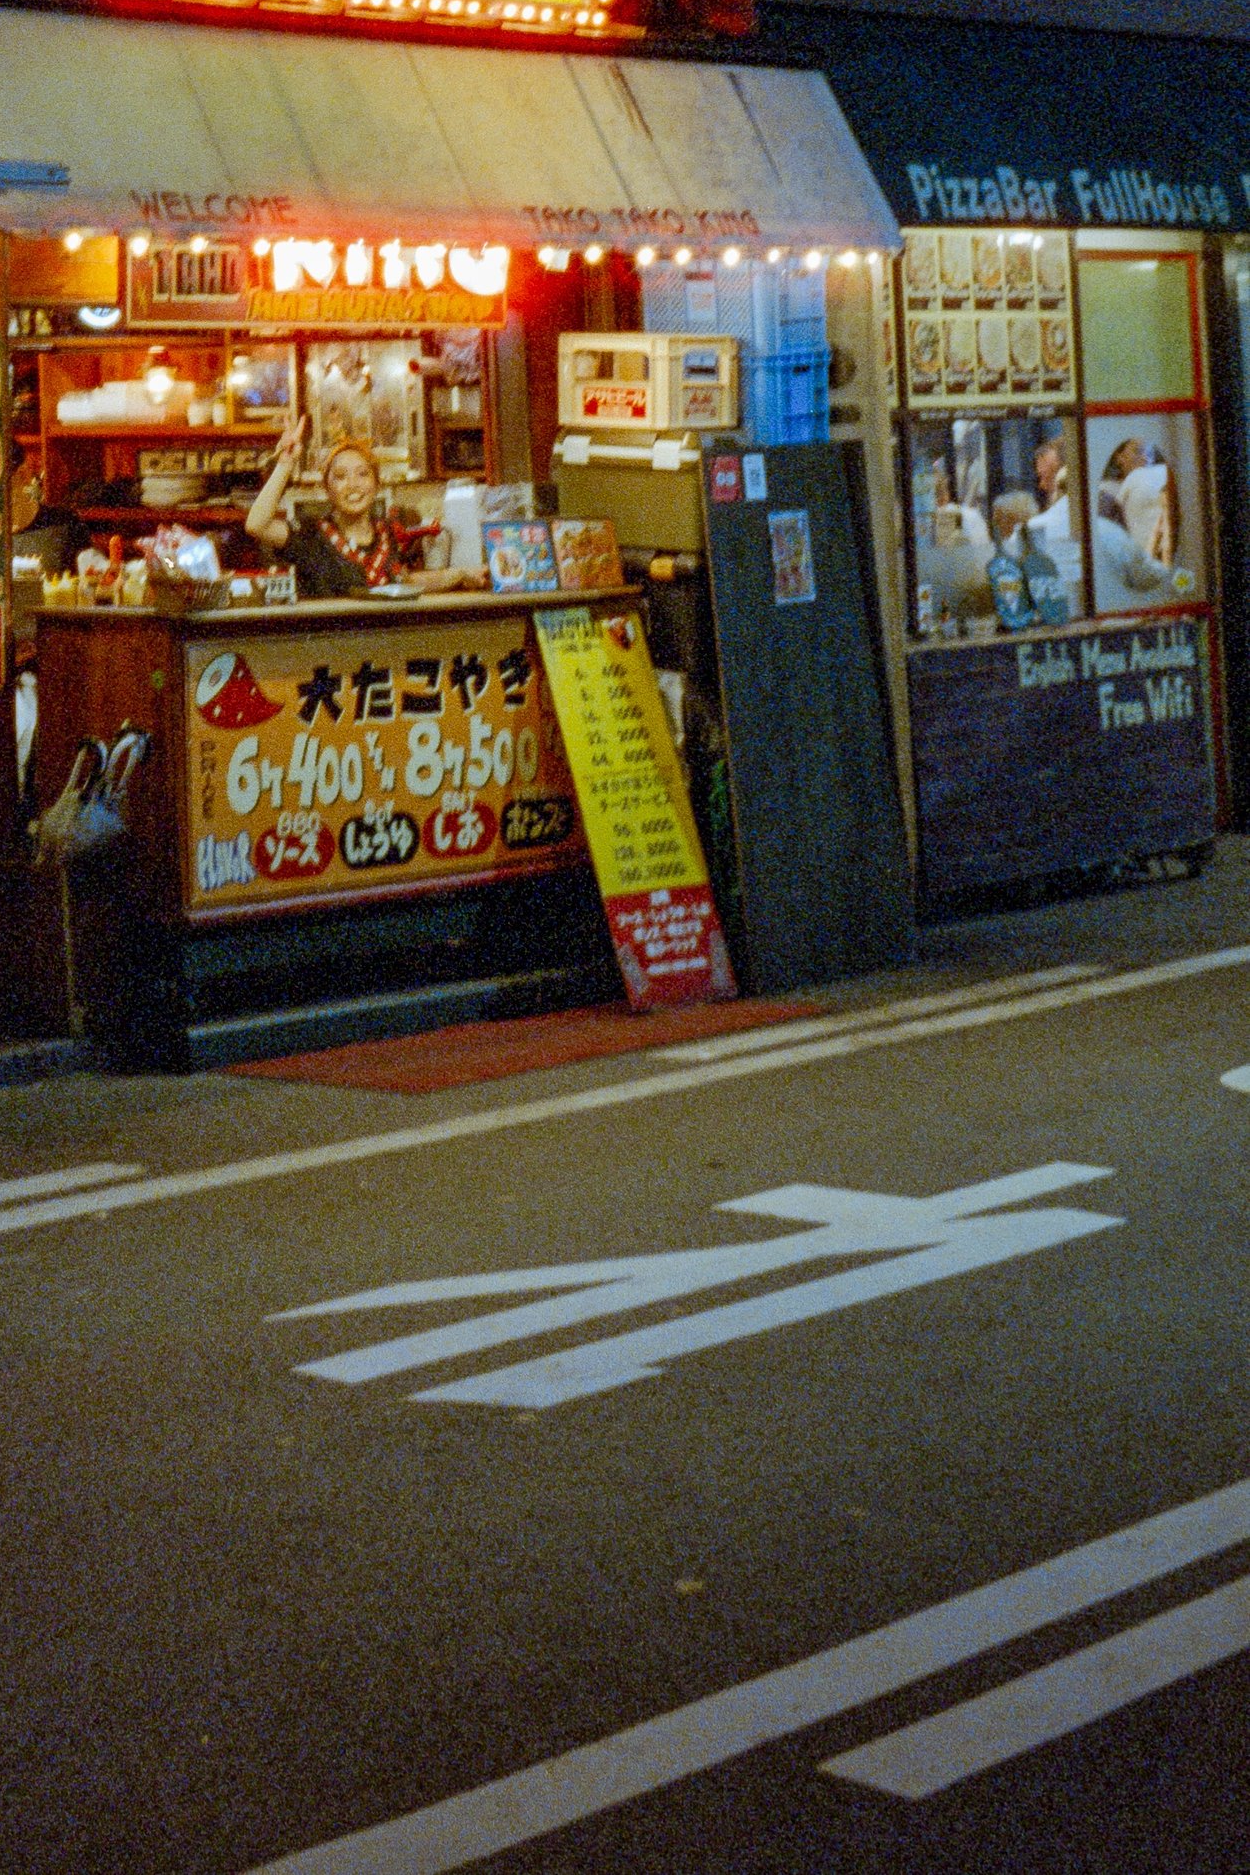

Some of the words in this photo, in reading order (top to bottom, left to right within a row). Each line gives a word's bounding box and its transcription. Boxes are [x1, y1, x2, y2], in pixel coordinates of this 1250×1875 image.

[129, 189, 296, 224] WELCOME
[523, 205, 600, 235] TAKO
[610, 207, 685, 235] TAKO
[295, 648, 533, 727] 大たこやき
[1099, 681, 1146, 730] Free
[263, 823, 322, 874] ソース
[344, 816, 415, 866] しょうゆ
[432, 809, 486, 853] しお
